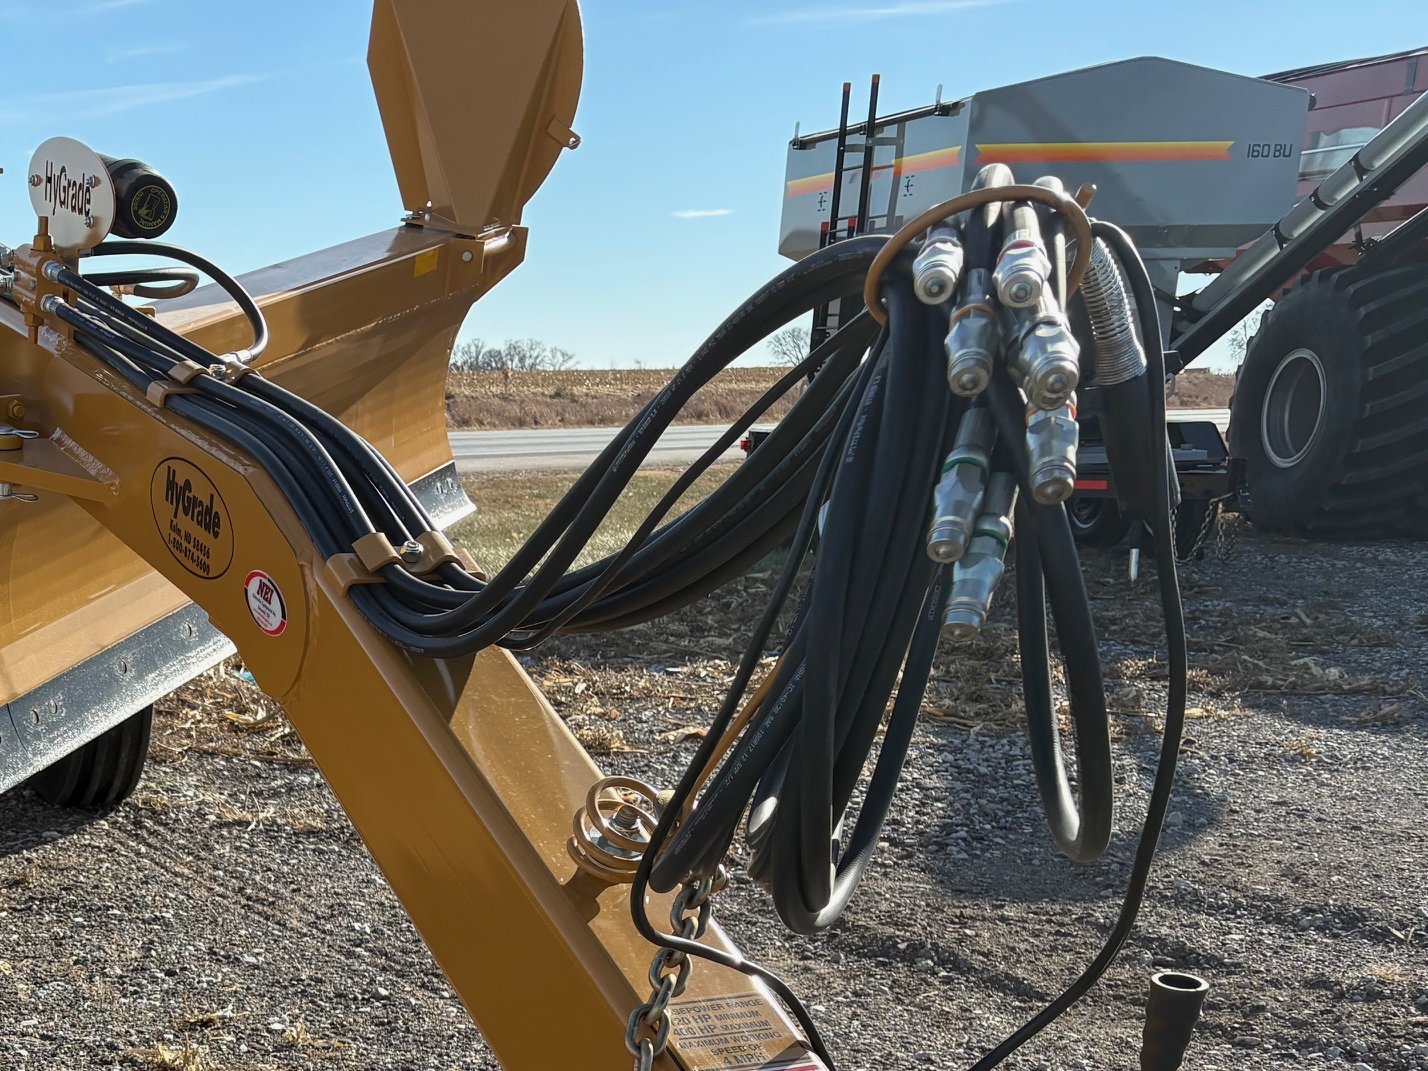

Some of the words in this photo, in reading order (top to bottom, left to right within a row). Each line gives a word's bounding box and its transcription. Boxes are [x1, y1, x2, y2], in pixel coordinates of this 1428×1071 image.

[1247, 143, 1270, 158] 160
[1273, 143, 1293, 158] BU
[44, 160, 91, 217] HyGrade
[139, 218, 162, 227] MANUAL
[165, 465, 220, 540] HyGrade
[257, 579, 274, 606] NEI
[671, 1002, 725, 1016] SEPOWER
[728, 999, 764, 1010] RANGE
[692, 1013, 711, 1024] HP
[714, 1010, 762, 1021] MINIMUM
[673, 1027, 696, 1037] 400
[697, 1025, 718, 1036] HP
[720, 1020, 772, 1032] MAXIMUM
[678, 1037, 730, 1049] MAXIMUM
[730, 1031, 782, 1043] WORKING
[711, 1044, 747, 1056] SPEED
[748, 1042, 763, 1052] OF
[723, 1056, 733, 1066] 4
[734, 1052, 766, 1065] MPH
